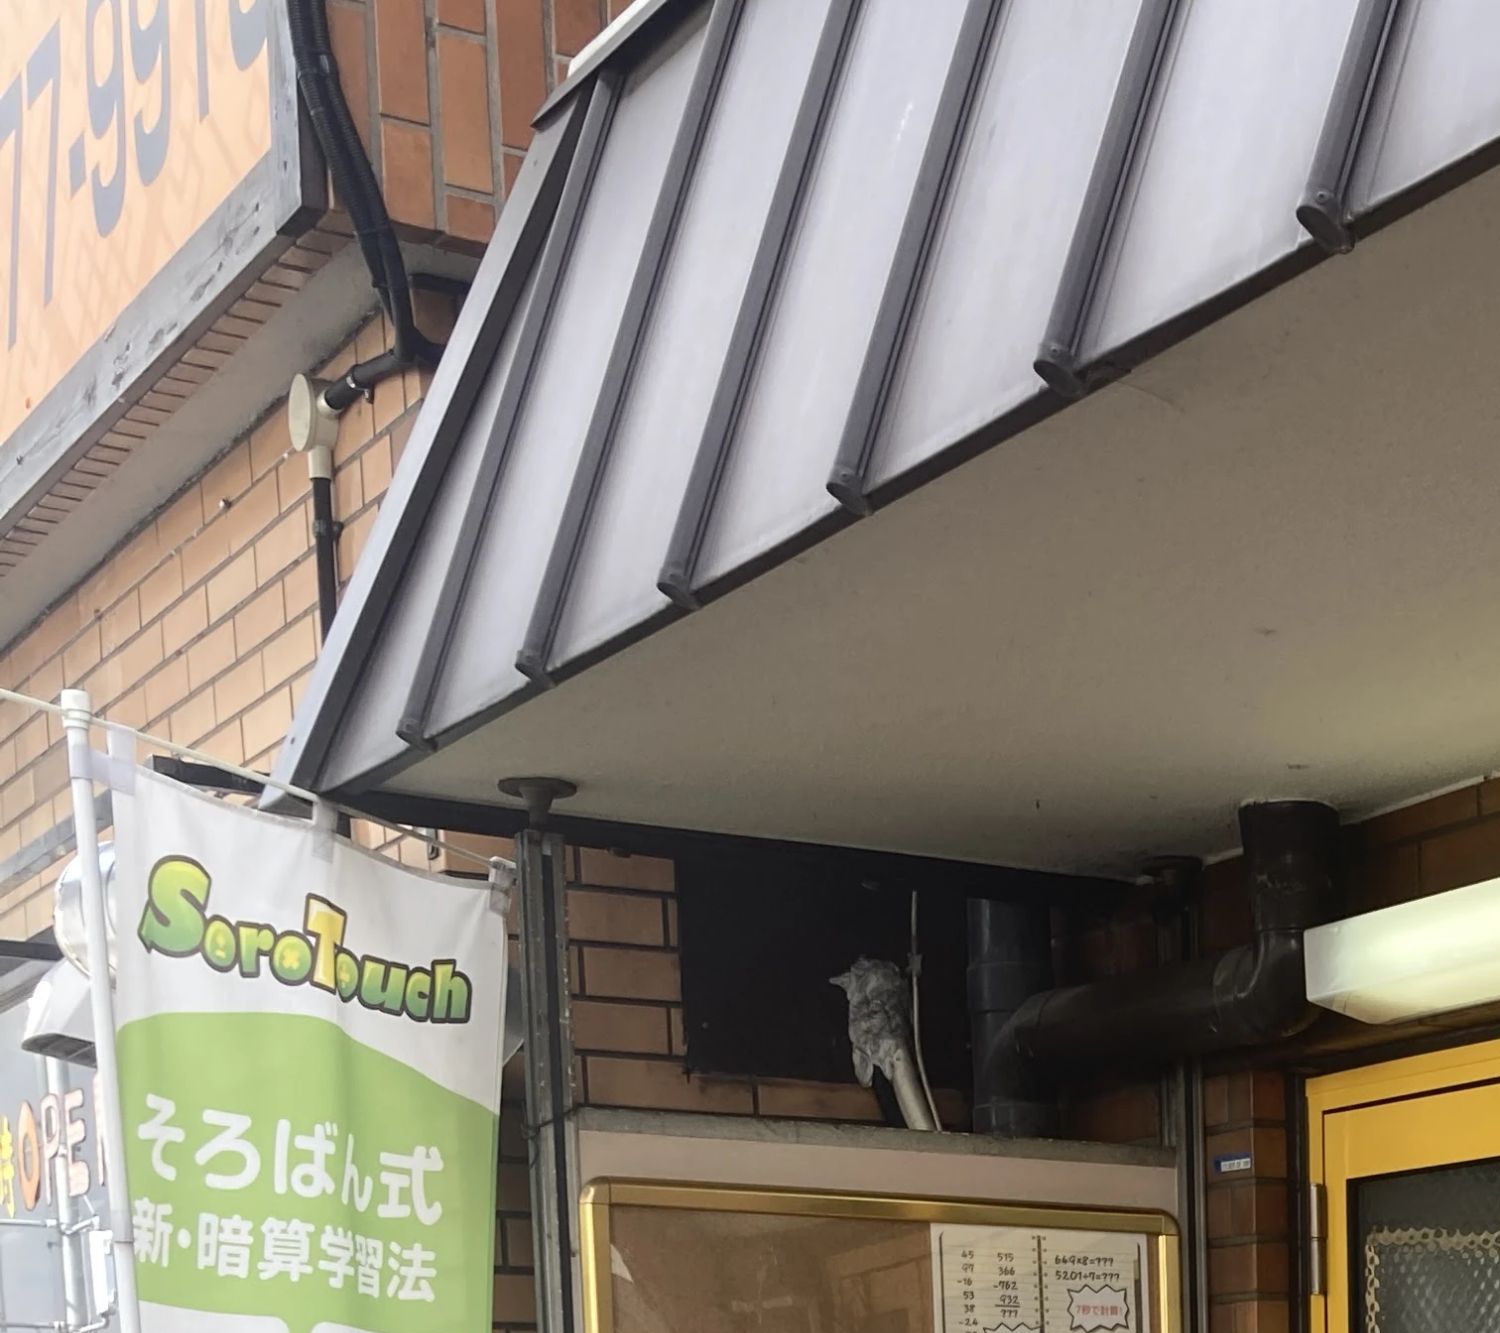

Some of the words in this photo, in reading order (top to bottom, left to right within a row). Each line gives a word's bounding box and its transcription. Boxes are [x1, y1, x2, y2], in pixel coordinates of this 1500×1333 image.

[138, 855, 472, 1023] SoroTouch
[137, 1092, 445, 1226] そろばん式
[132, 1196, 438, 1303] 新・暗算学習法
[997, 1252, 1014, 1262] 515
